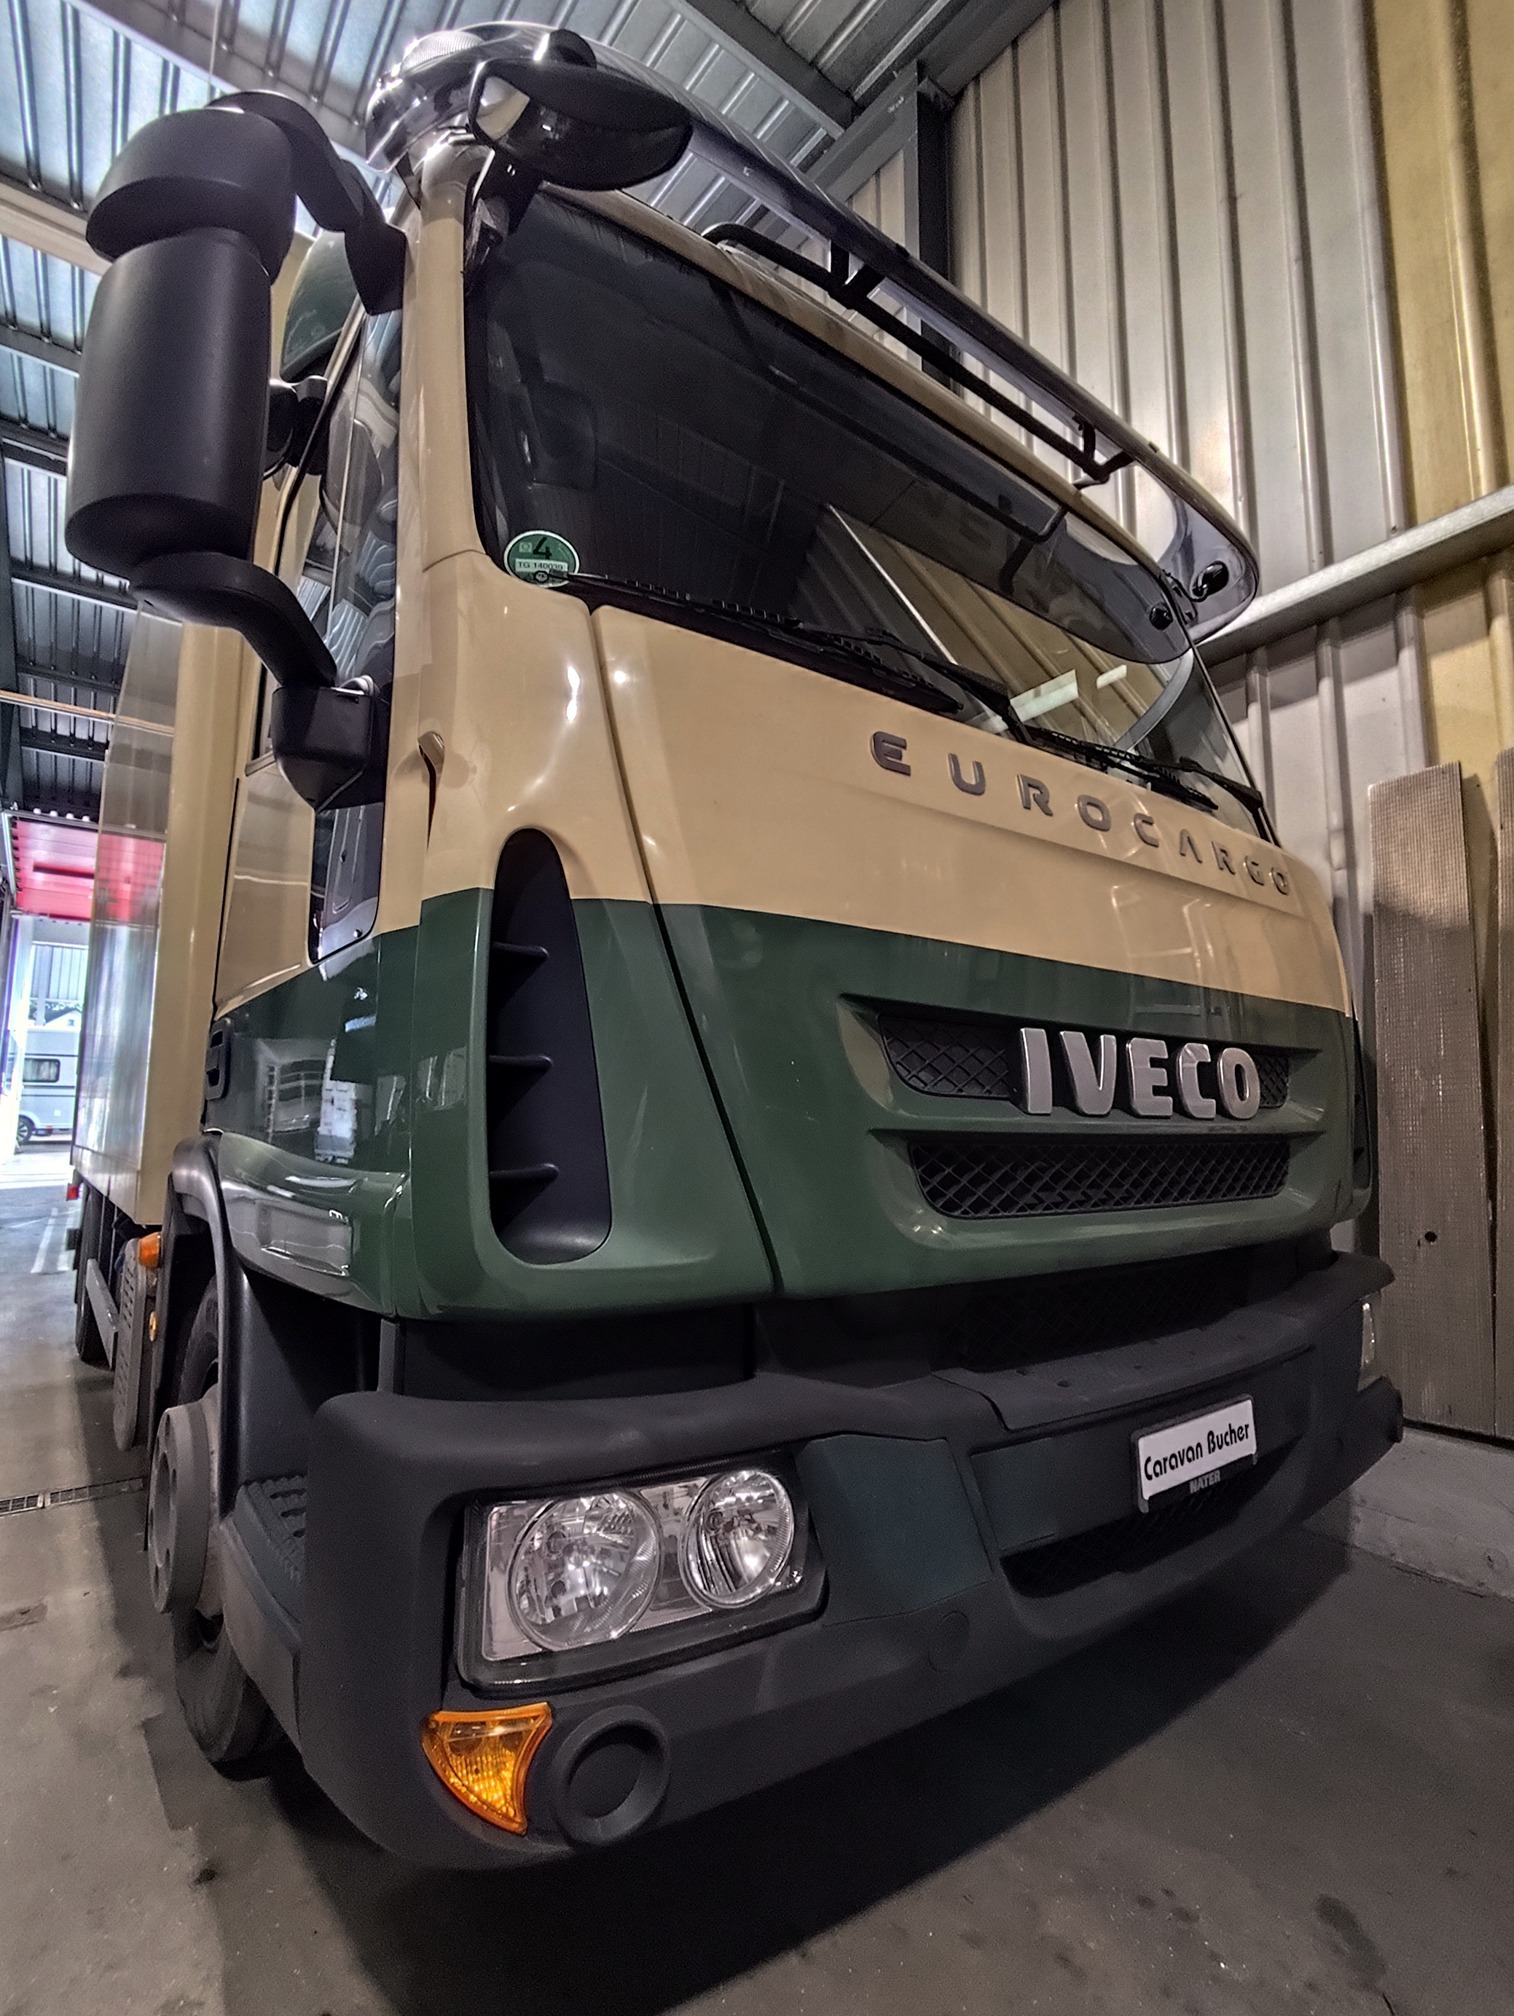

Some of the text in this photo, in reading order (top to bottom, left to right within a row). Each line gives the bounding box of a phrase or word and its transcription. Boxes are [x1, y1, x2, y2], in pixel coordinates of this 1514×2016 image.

[532, 536, 552, 559] 4
[870, 731, 1291, 896] EUROCARGO
[1020, 1027, 1261, 1120] IVECO
[1144, 1423, 1250, 1481] Caravan Bucher
